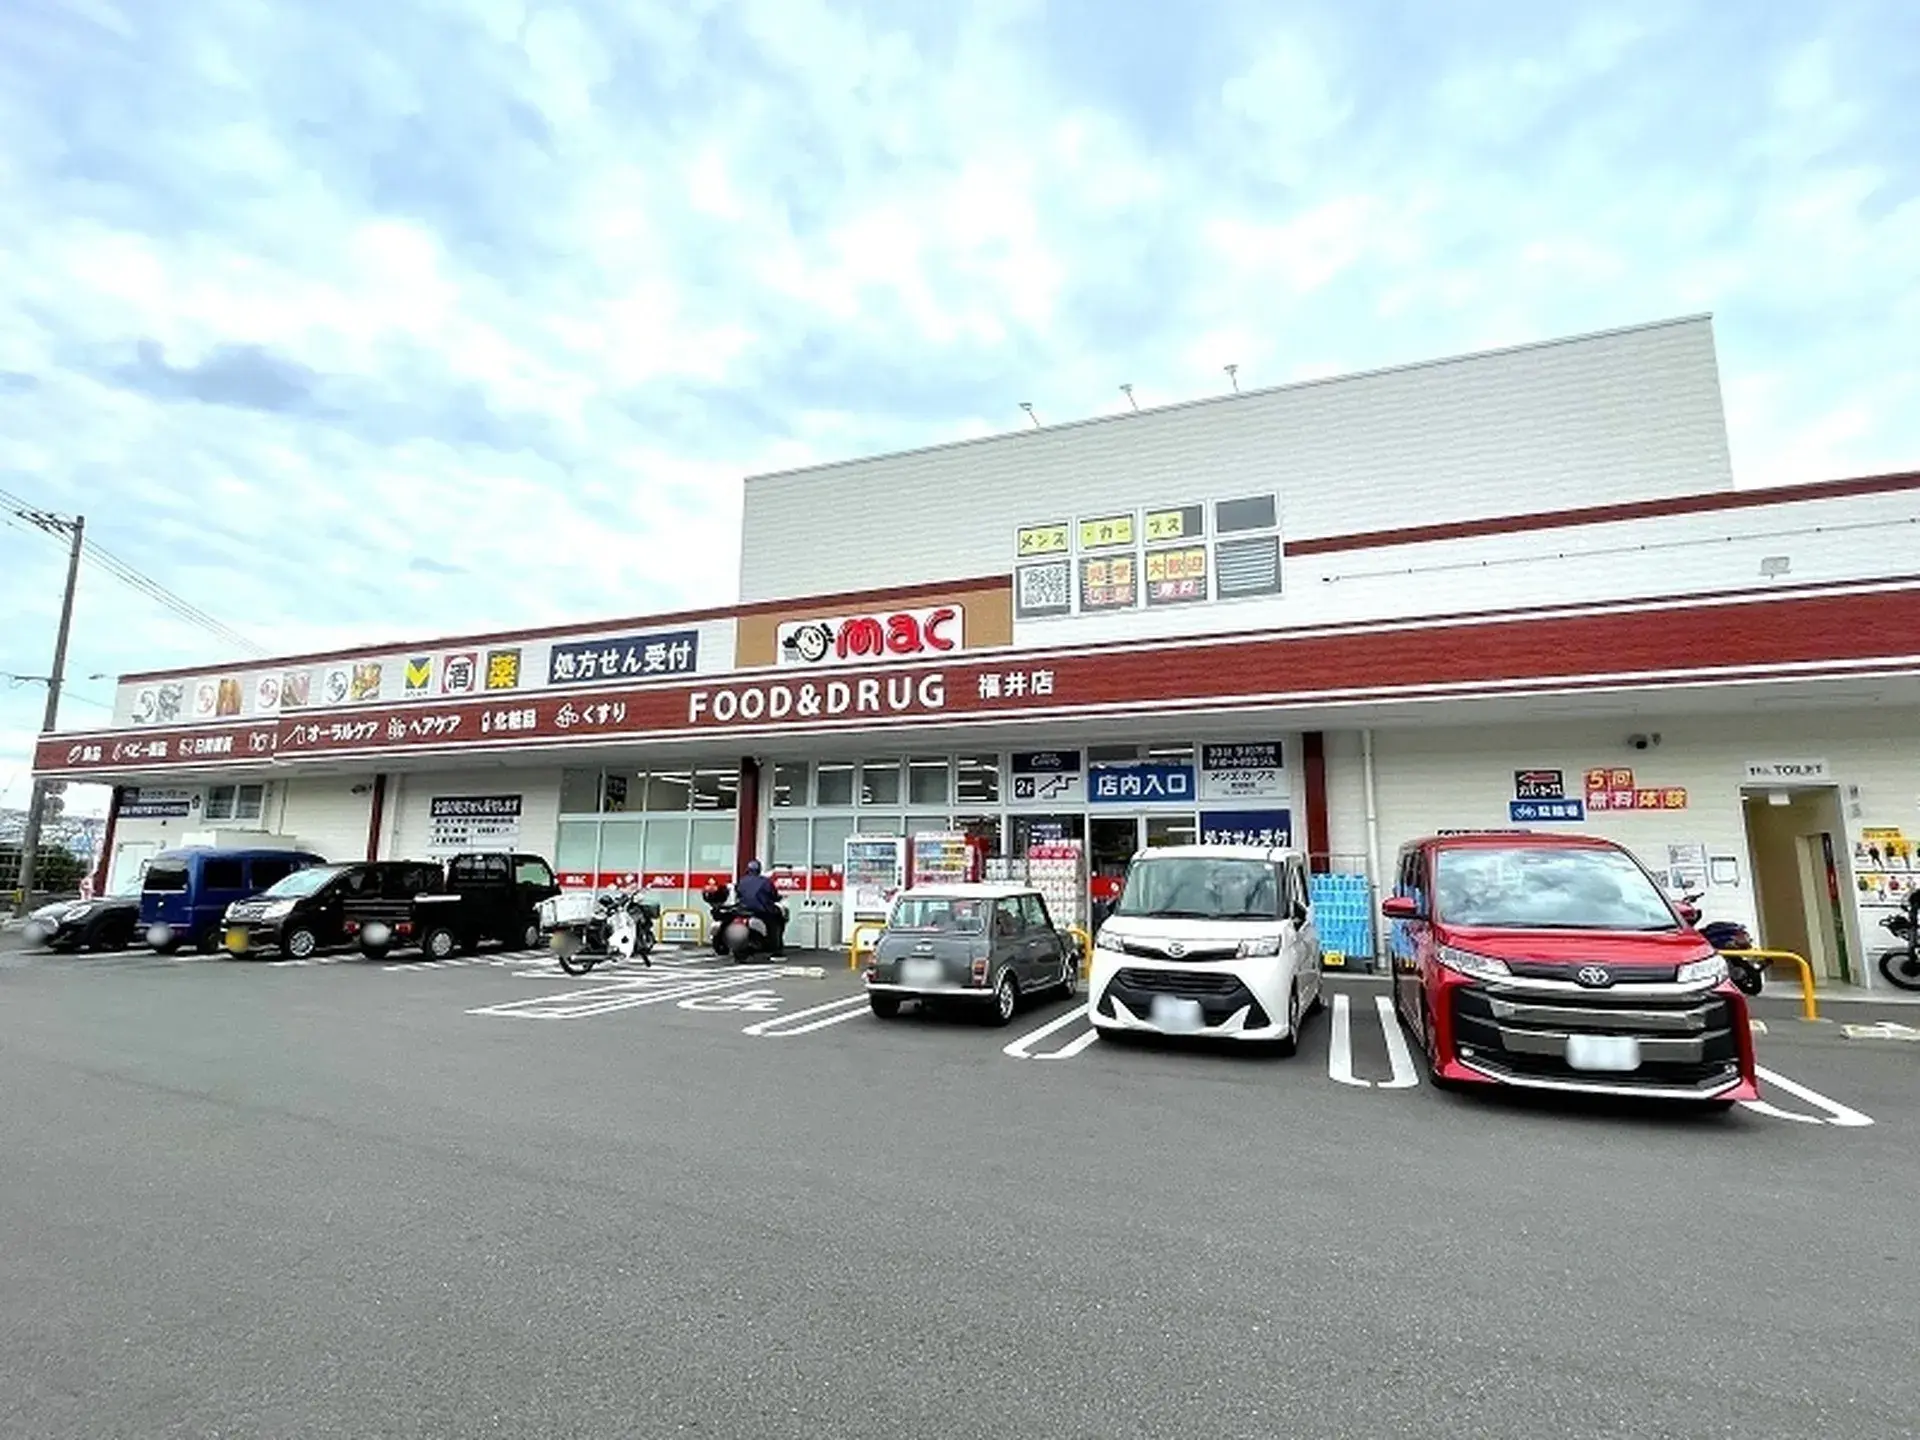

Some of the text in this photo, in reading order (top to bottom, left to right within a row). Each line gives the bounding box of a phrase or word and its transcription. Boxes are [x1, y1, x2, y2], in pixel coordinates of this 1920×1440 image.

[836, 609, 955, 659] mac
[553, 640, 692, 679] 処方せん受付
[449, 662, 471, 688] 酒
[978, 670, 1054, 699] 福井店
[688, 674, 945, 722] FOOD&DRUG
[582, 702, 626, 723] くすり
[307, 721, 379, 742] オーラルケア
[410, 715, 461, 735] ヘアケア
[1016, 779, 1034, 795] 2F
[1097, 774, 1187, 795] 店内入口
[1588, 770, 1631, 788] 5回
